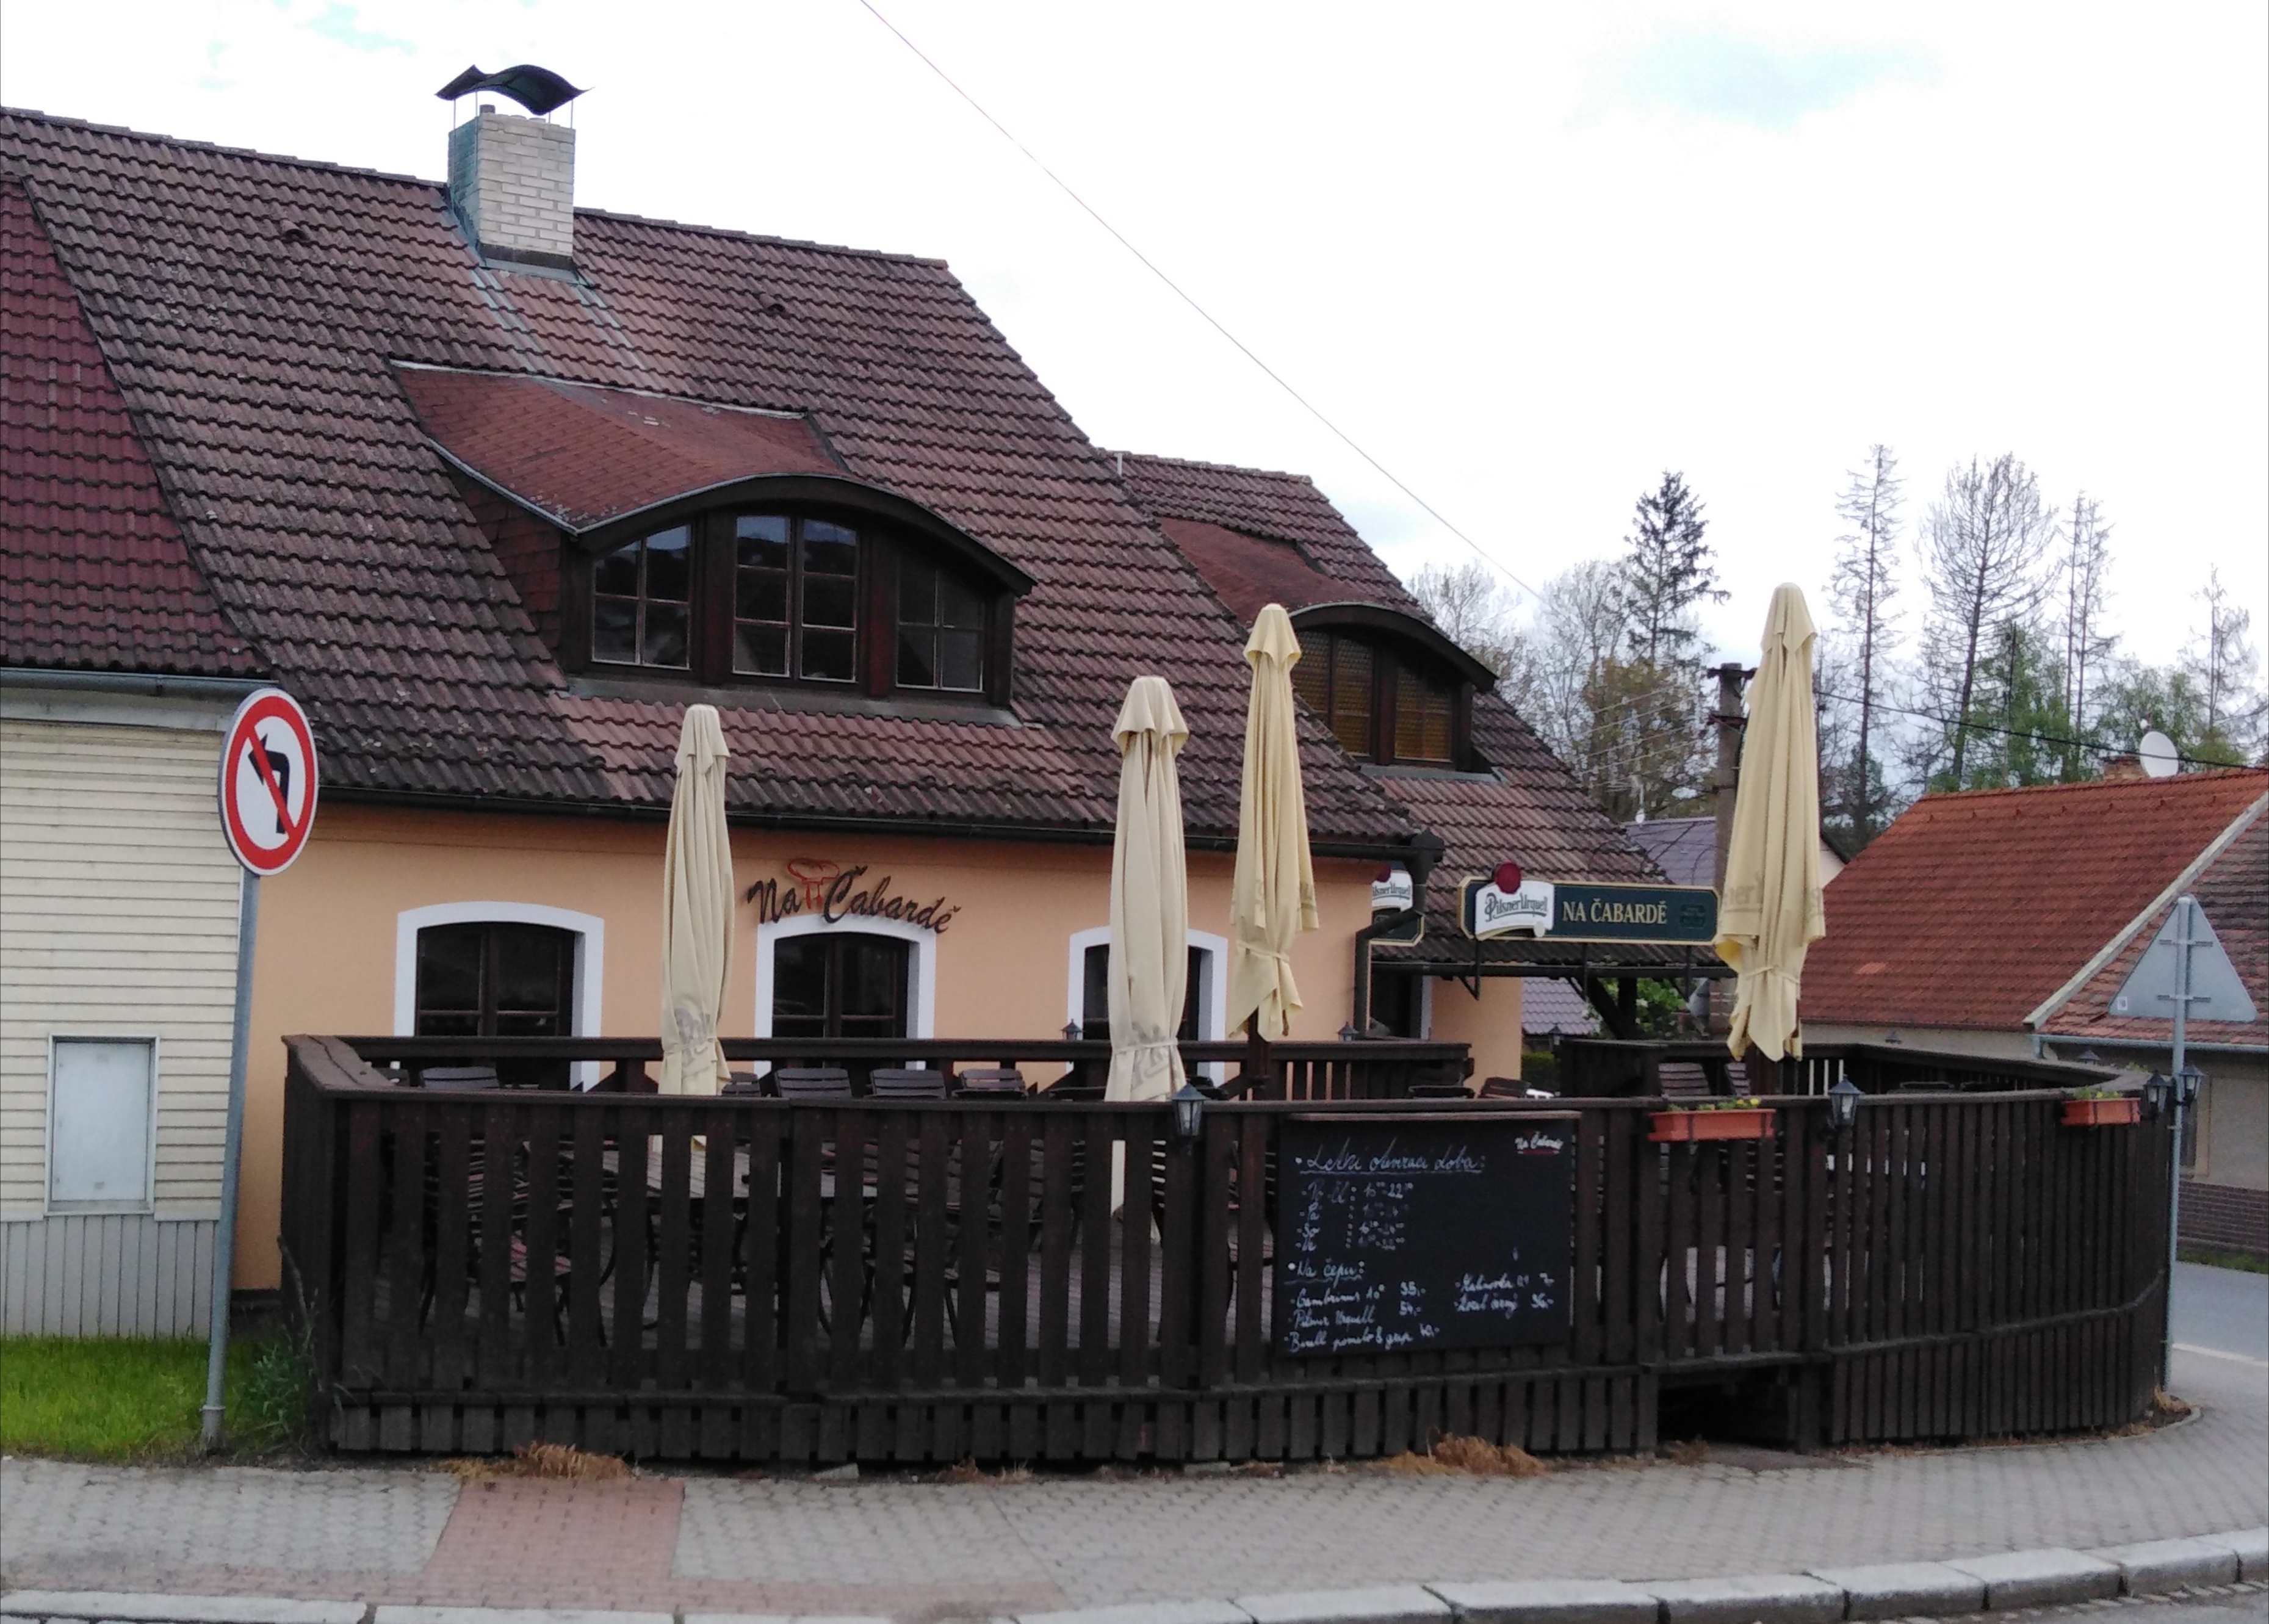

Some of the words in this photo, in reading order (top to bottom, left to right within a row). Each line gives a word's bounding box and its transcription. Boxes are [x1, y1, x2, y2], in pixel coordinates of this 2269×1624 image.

[748, 878, 803, 924] Na
[823, 864, 962, 934] Čabardě
[1484, 892, 1520, 922] Pilsner
[1562, 901, 1587, 922] NA
[1590, 898, 1668, 924] ČABARDĚ
